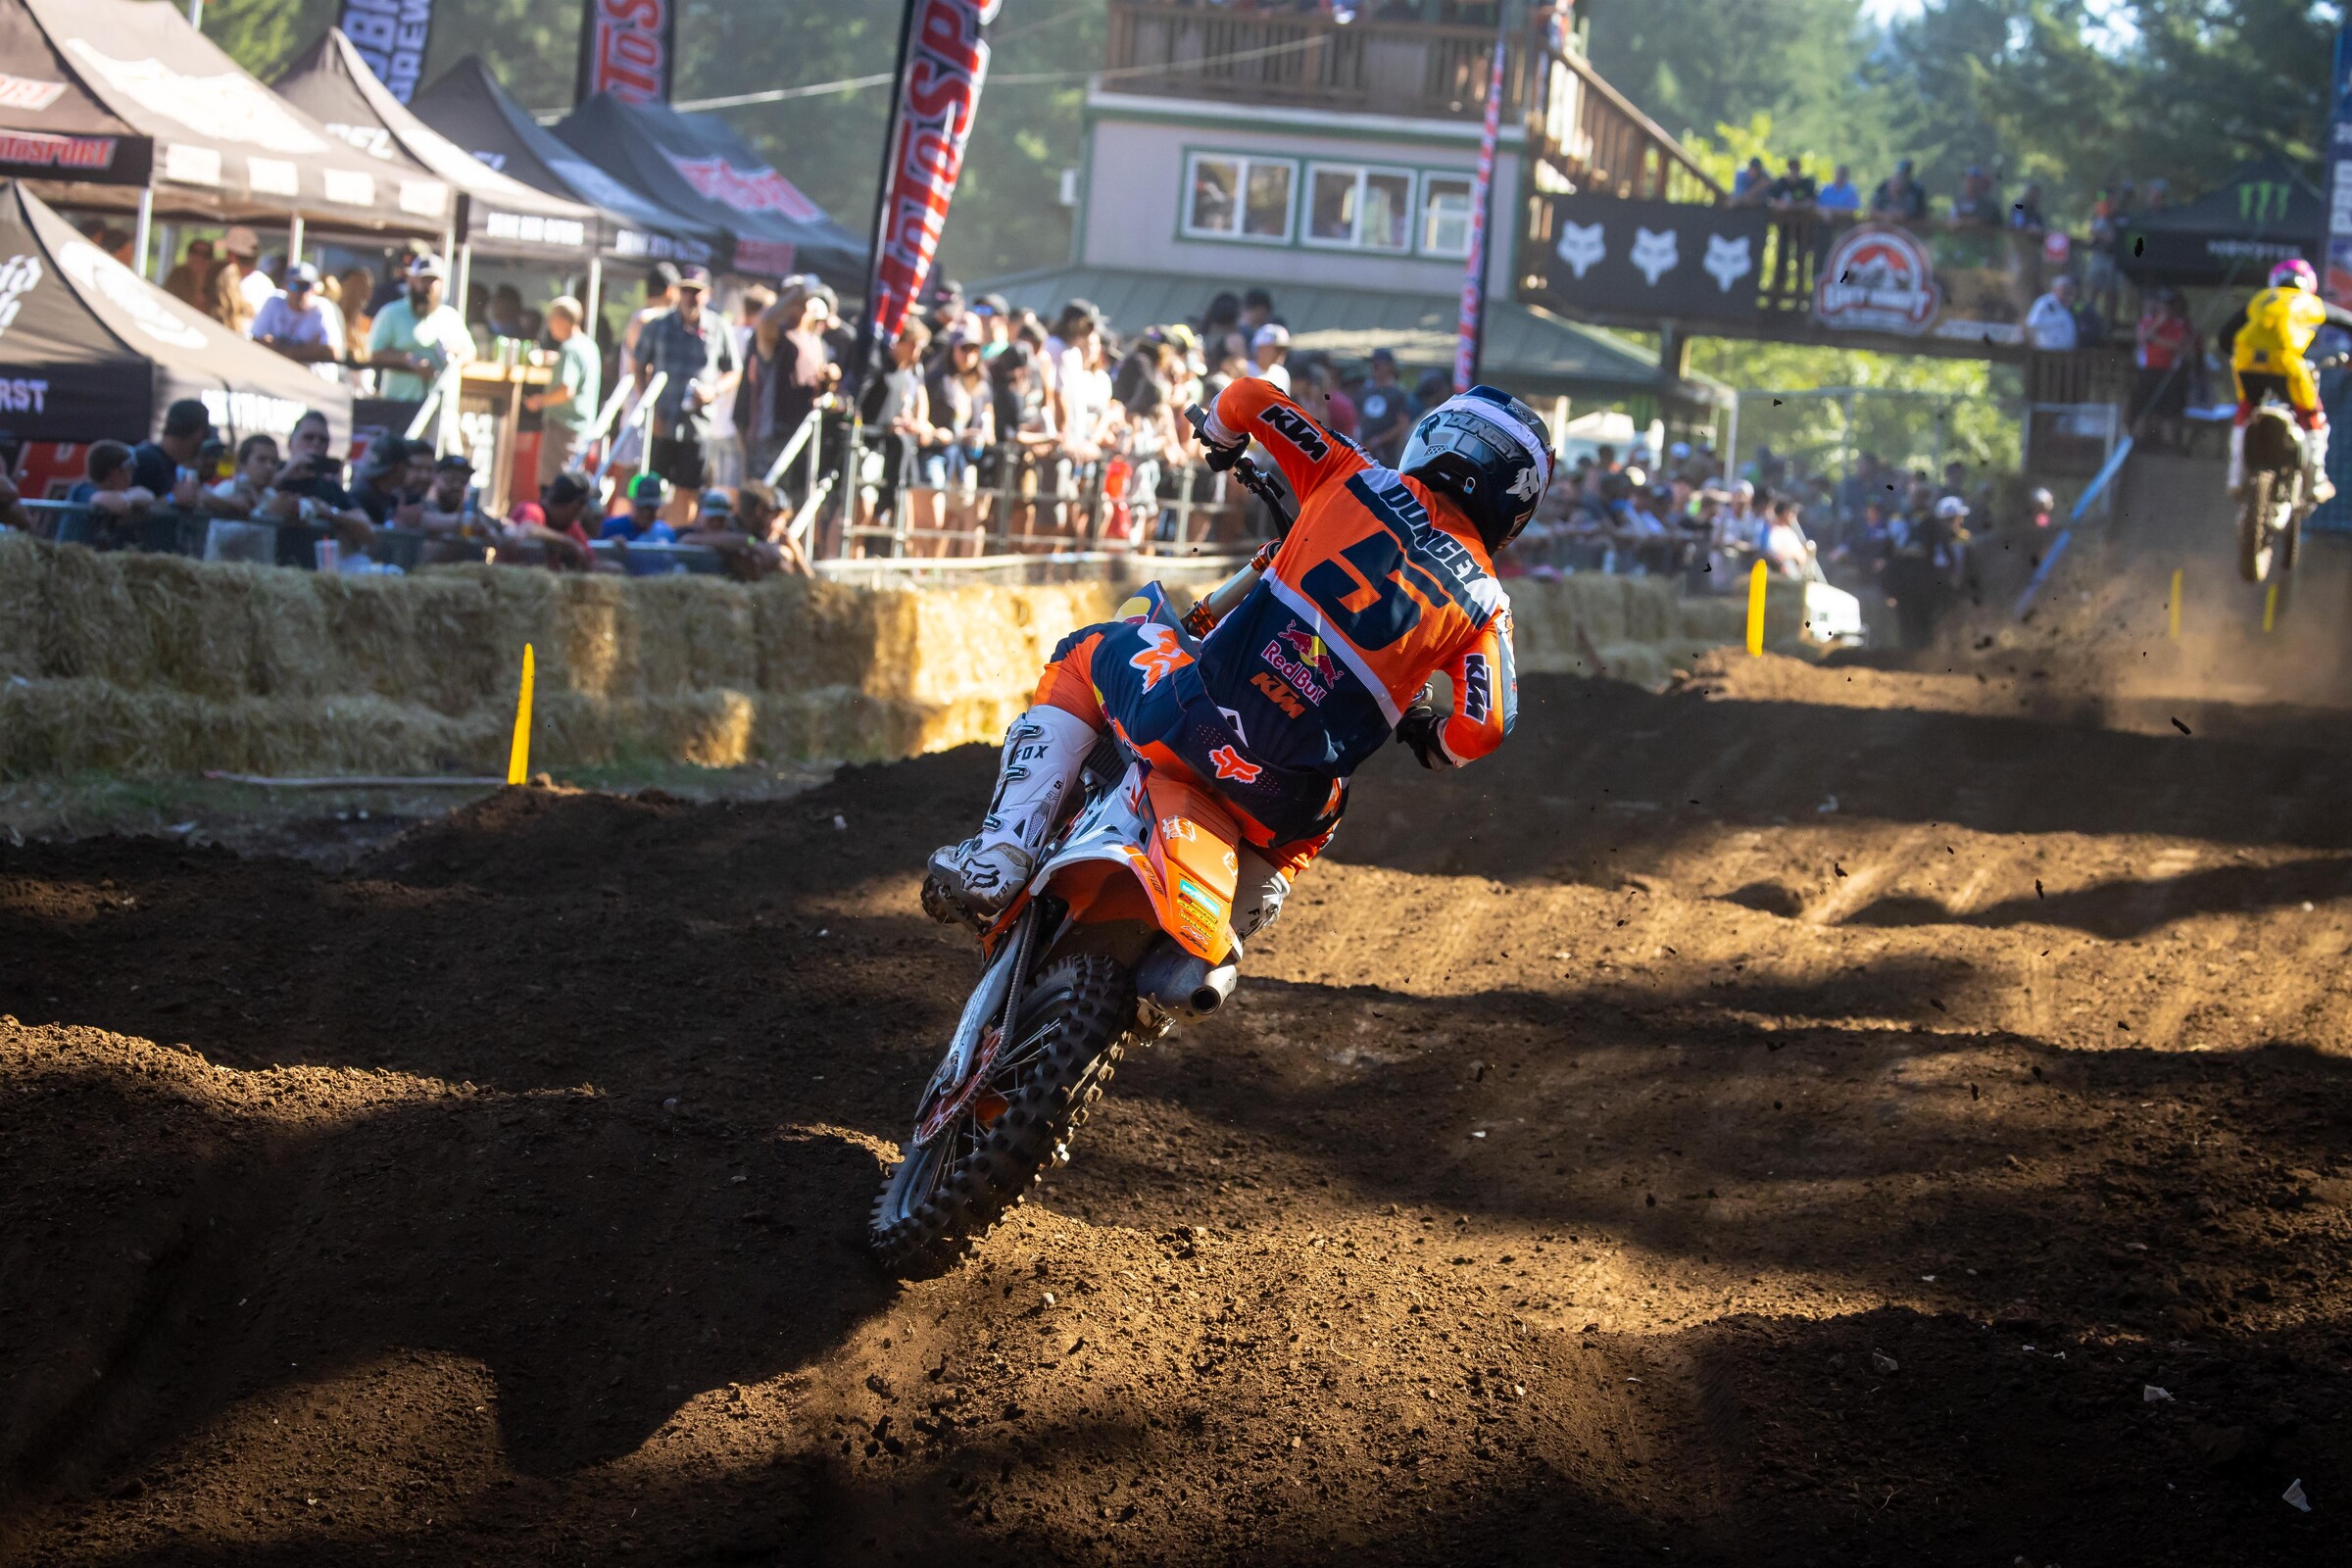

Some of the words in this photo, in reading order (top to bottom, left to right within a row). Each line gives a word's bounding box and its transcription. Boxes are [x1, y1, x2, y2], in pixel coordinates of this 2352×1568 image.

[1258, 404, 1331, 464] KTM
[1445, 414, 1525, 463] DUNGEY
[1378, 483, 1488, 587] DUNGEY
[1300, 530, 1450, 652] 5
[1250, 671, 1306, 718] KTM
[1261, 640, 1302, 680] Red
[1292, 667, 1327, 707] Bull
[1463, 653, 1493, 725] KTM
[1013, 746, 1049, 764] FOX
